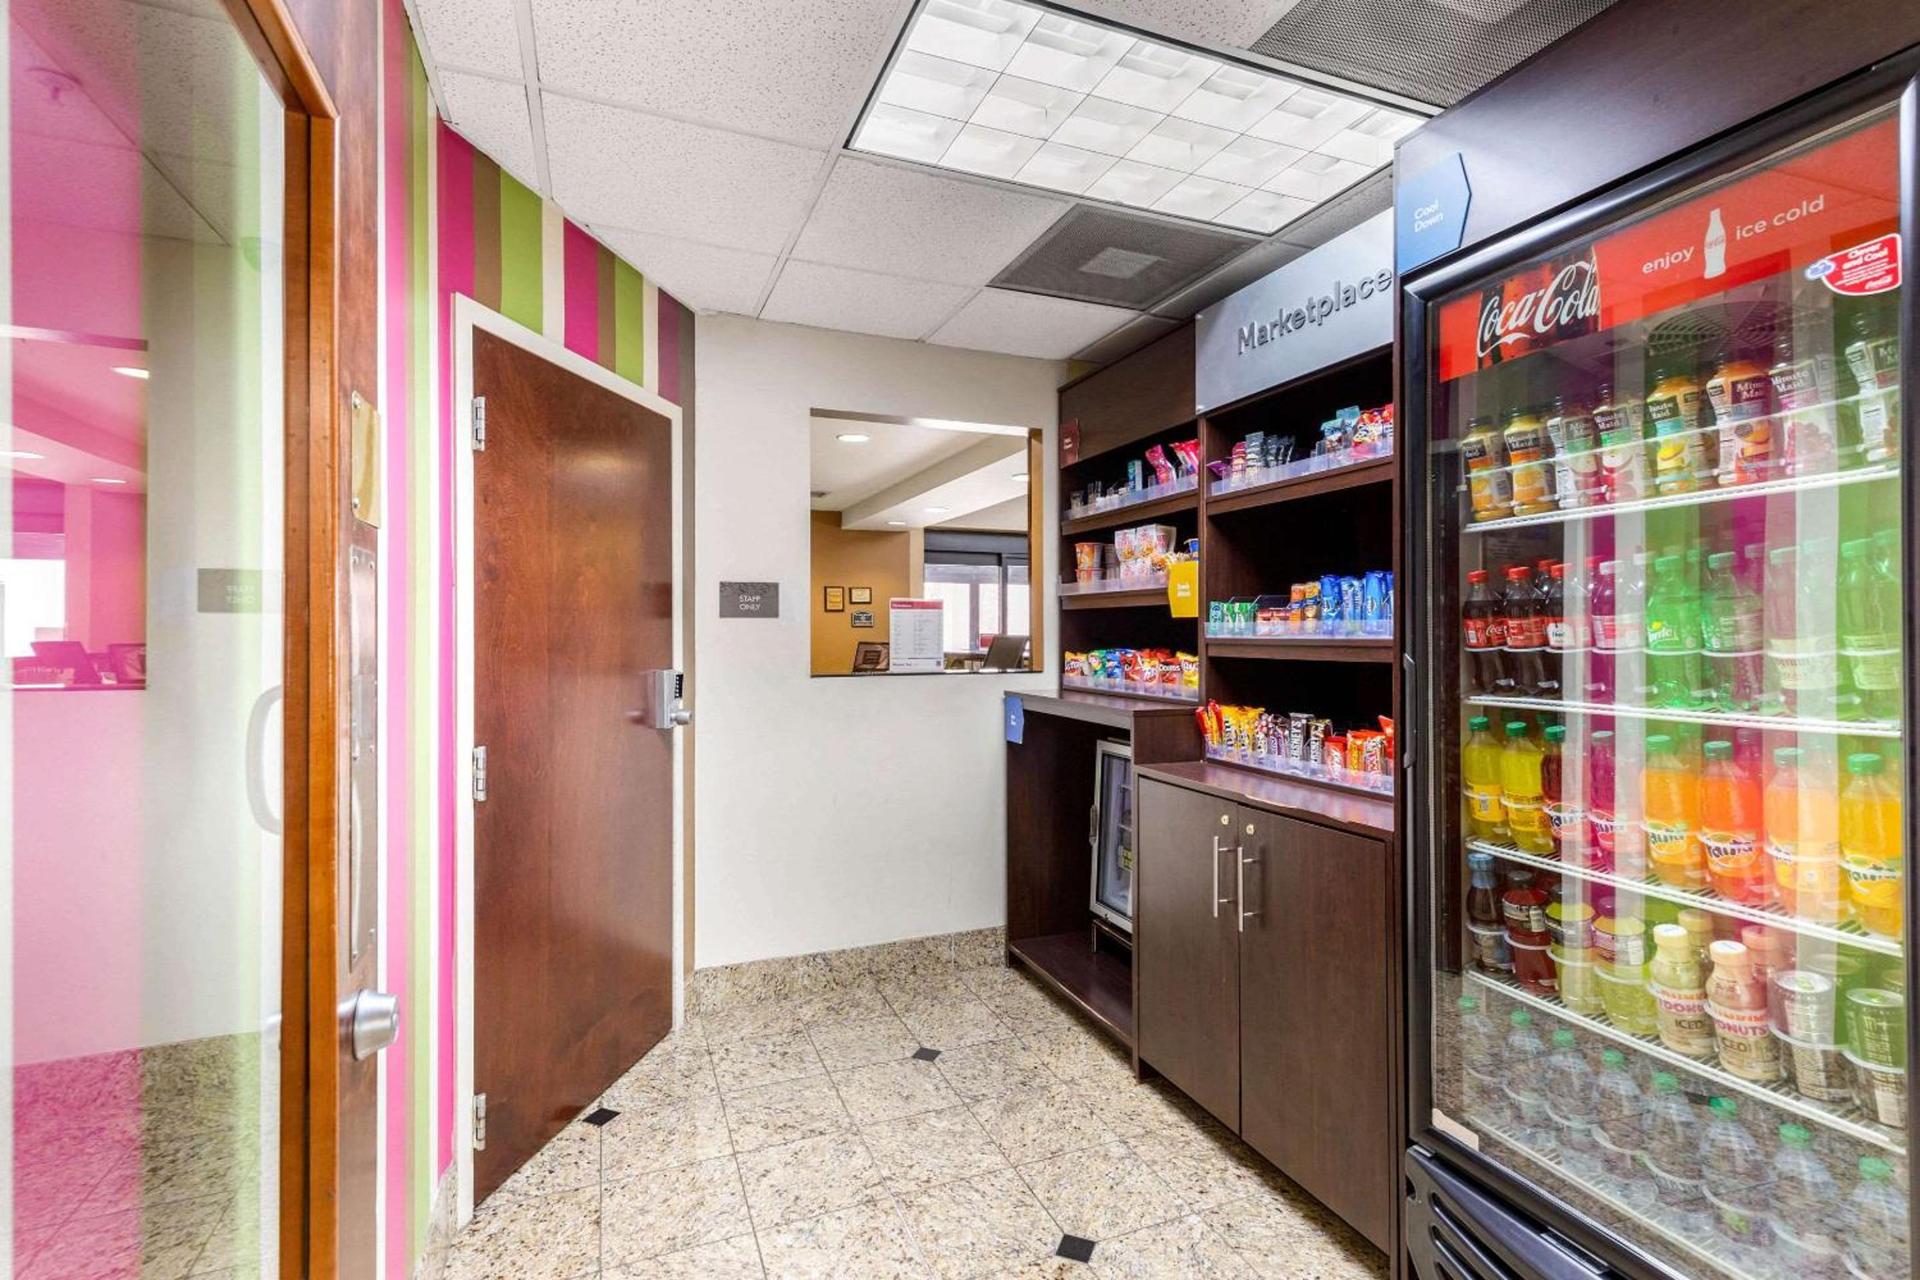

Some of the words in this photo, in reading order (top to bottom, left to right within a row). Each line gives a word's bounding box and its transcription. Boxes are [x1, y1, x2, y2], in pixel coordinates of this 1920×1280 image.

[1414, 197, 1439, 219] Cool
[1414, 212, 1444, 232] Down
[1642, 246, 1694, 274] enjoy
[1736, 220, 1767, 240] ice
[1773, 194, 1824, 226] cold
[1237, 267, 1393, 355] Marketplace
[1477, 261, 1599, 357] Coca-Cola
[739, 594, 761, 603] STAFF
[739, 603, 761, 611] ONLY
